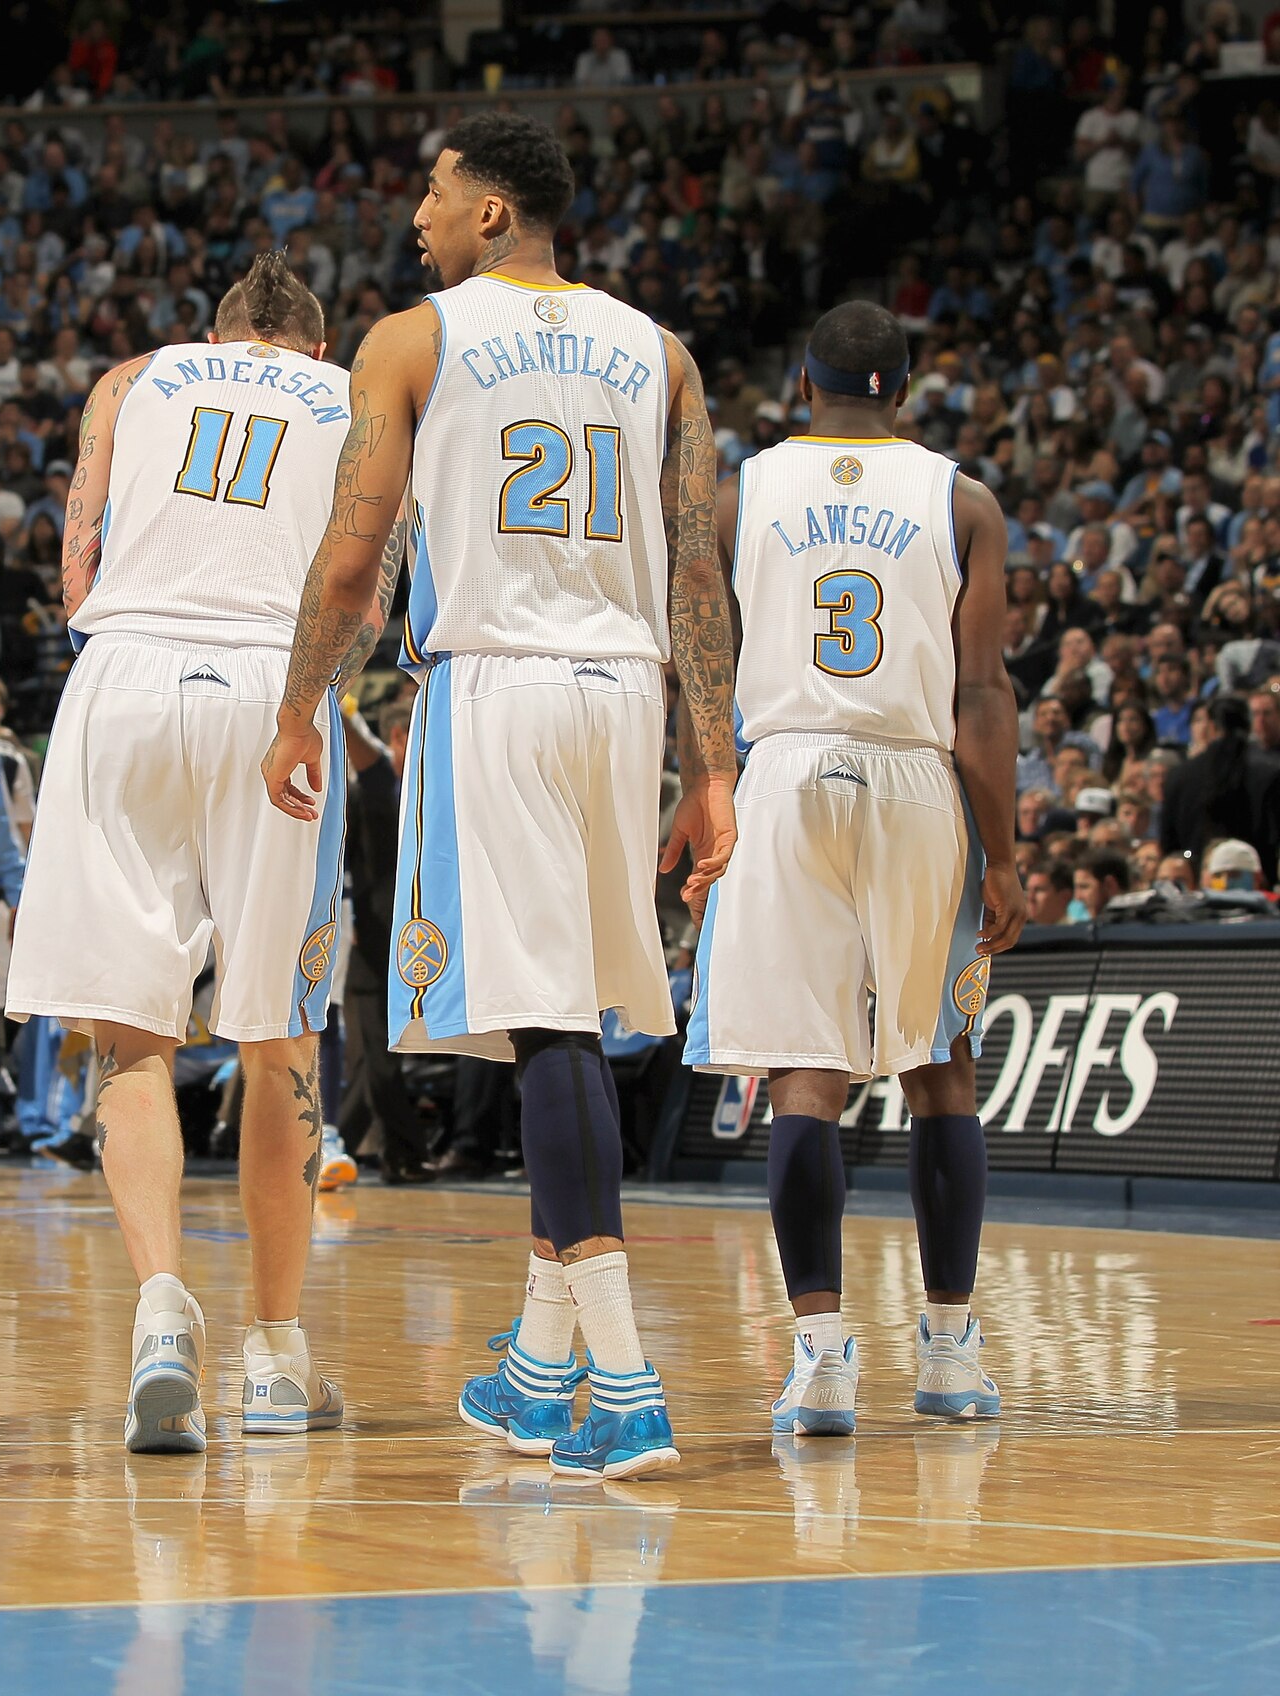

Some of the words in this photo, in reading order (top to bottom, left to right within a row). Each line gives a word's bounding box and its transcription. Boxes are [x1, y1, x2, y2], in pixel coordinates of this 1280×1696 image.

[152, 357, 350, 424] ANDERSEN
[462, 331, 650, 404] CHANDLER
[173, 407, 289, 510] 11
[498, 419, 623, 542] 21
[771, 505, 921, 560] LAWSON
[813, 569, 884, 679] 3
